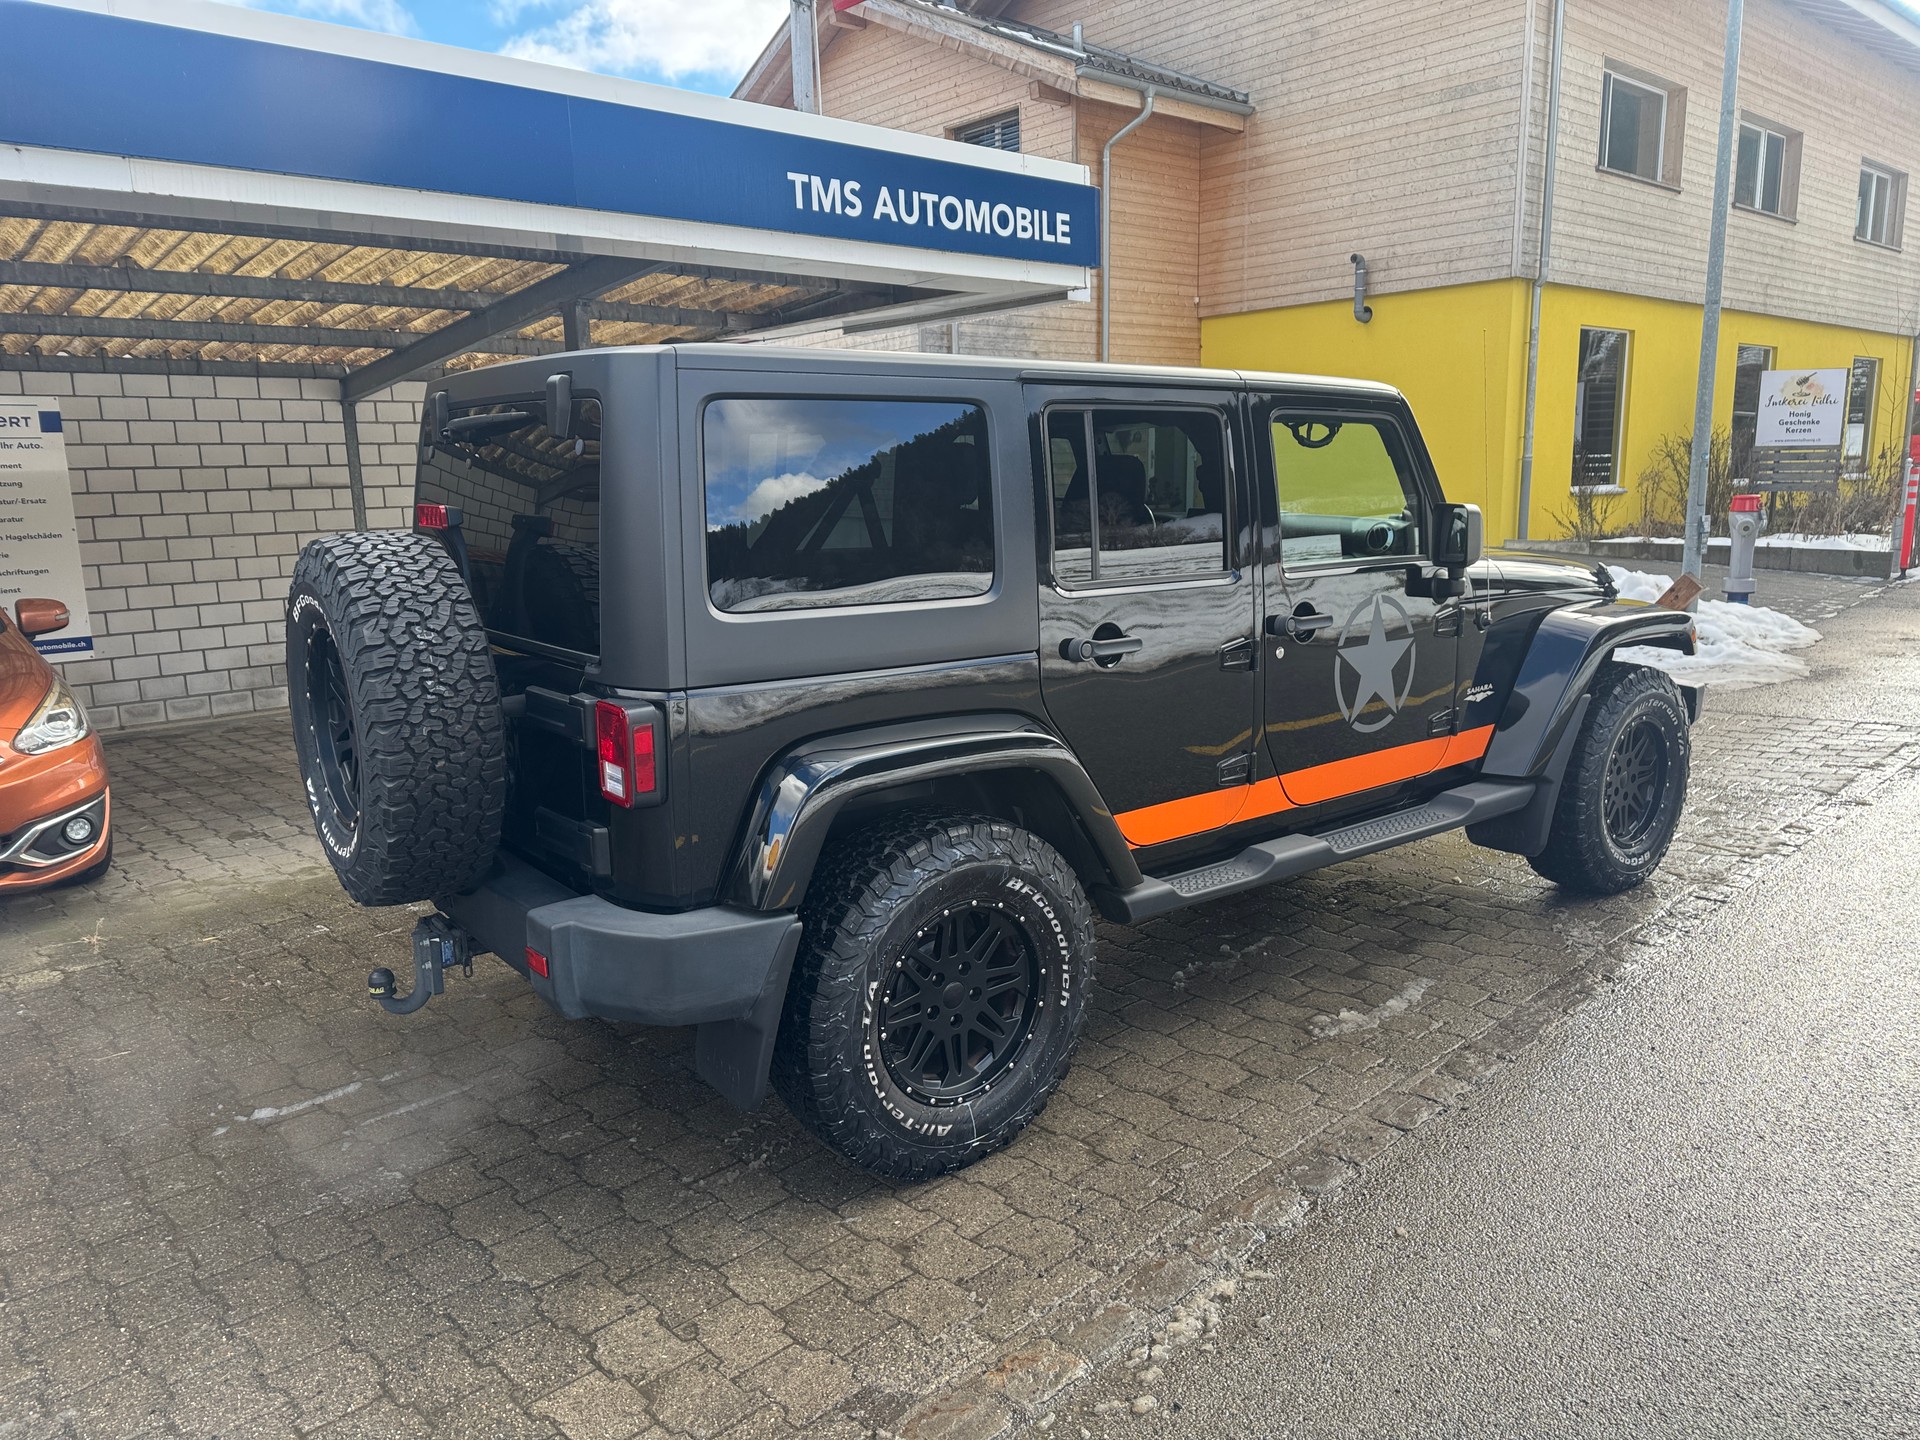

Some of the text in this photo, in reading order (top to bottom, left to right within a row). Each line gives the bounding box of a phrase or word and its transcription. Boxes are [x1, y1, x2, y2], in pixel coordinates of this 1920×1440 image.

[786, 171, 1071, 245] TMS AUTOMOBILE
[1789, 410, 1811, 418] Honig
[1778, 418, 1820, 426] Geschenke
[1785, 426, 1812, 434] Kerzen
[5, 532, 63, 541] Hagelschäden
[1466, 683, 1493, 695] SAHARA
[1006, 876, 1070, 1007] BFGoodrich
[863, 1044, 953, 1137] All-Terrain
